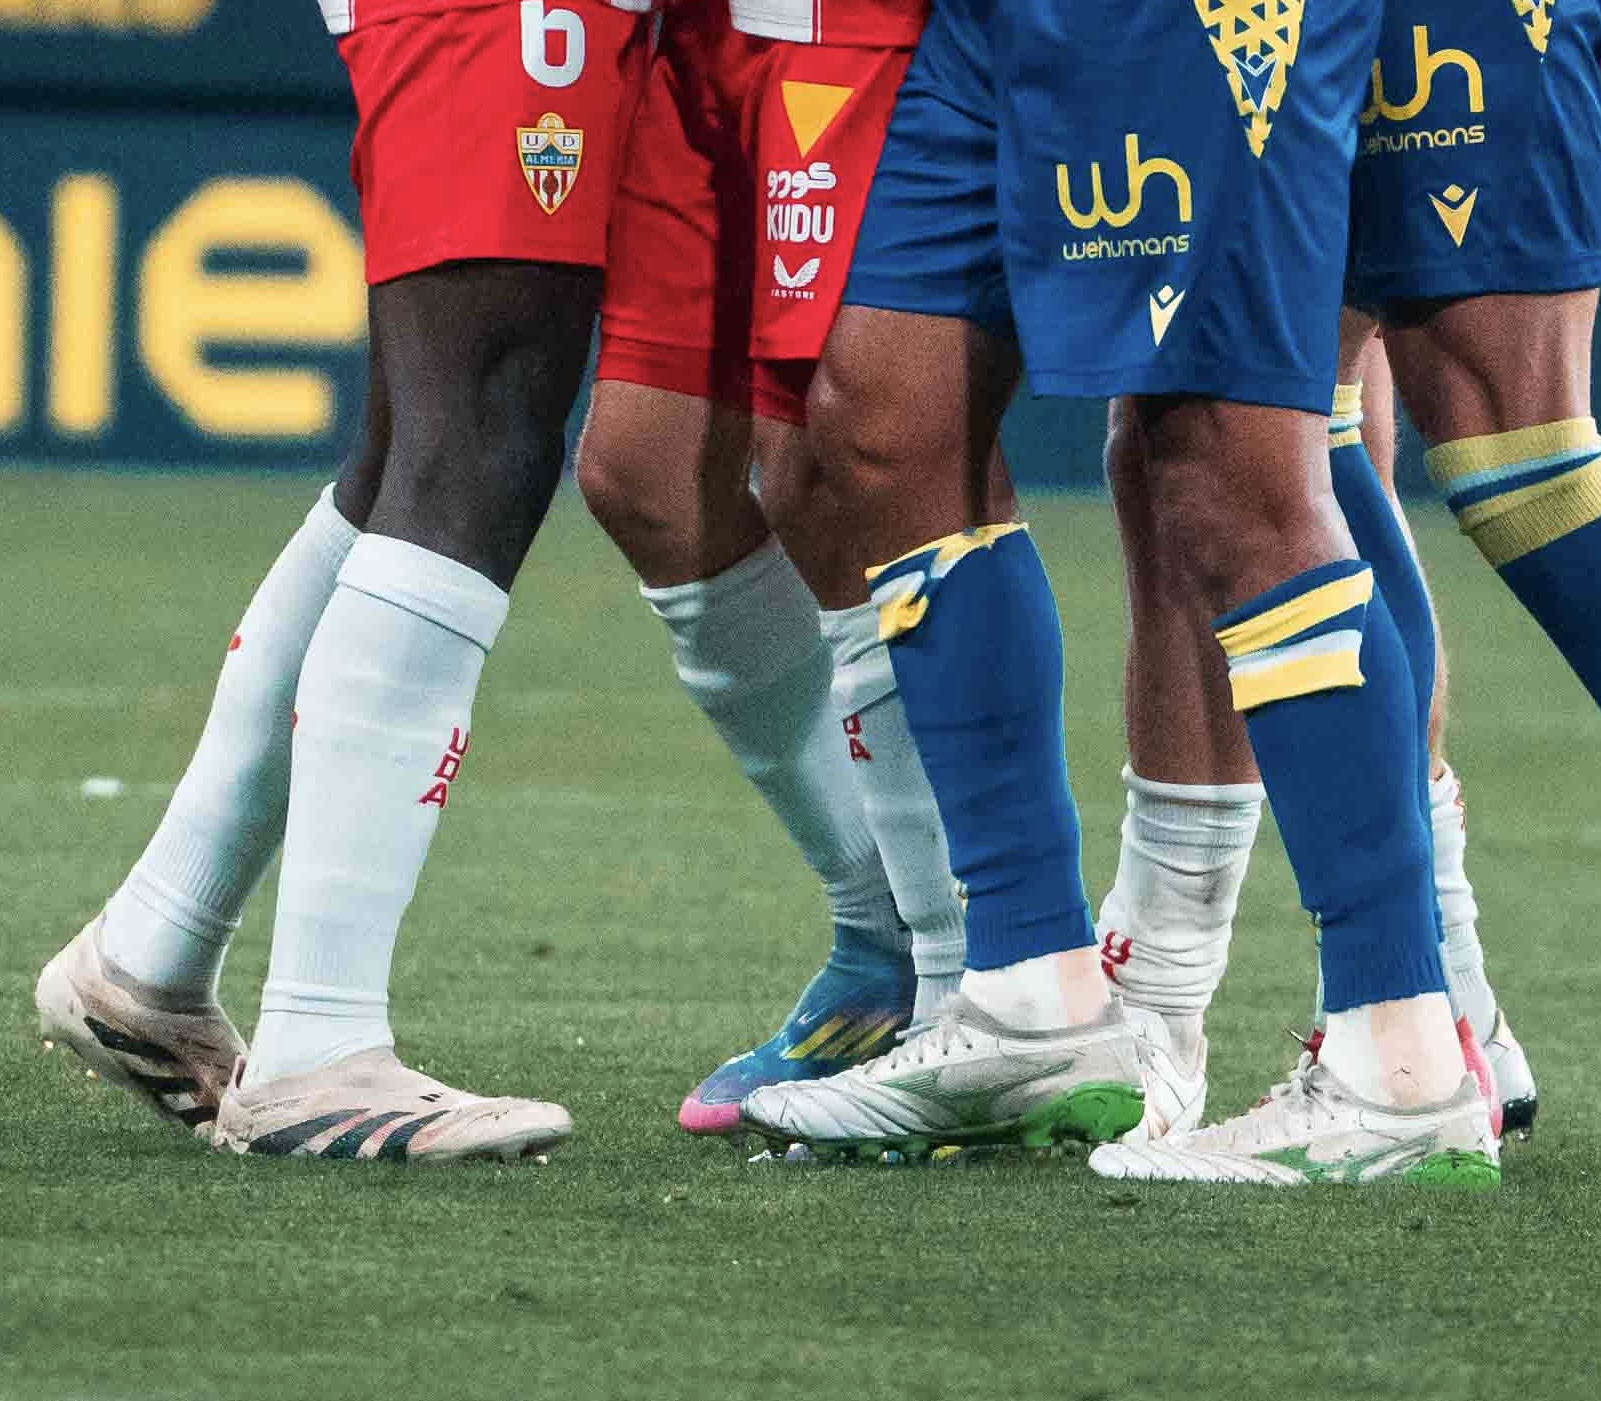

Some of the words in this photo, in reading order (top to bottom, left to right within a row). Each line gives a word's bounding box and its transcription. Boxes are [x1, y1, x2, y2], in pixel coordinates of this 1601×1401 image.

[1056, 133, 1192, 230] wh
[766, 203, 835, 244] KUDU
[1062, 233, 1191, 261] wehumans
[417, 726, 471, 810] UDA
